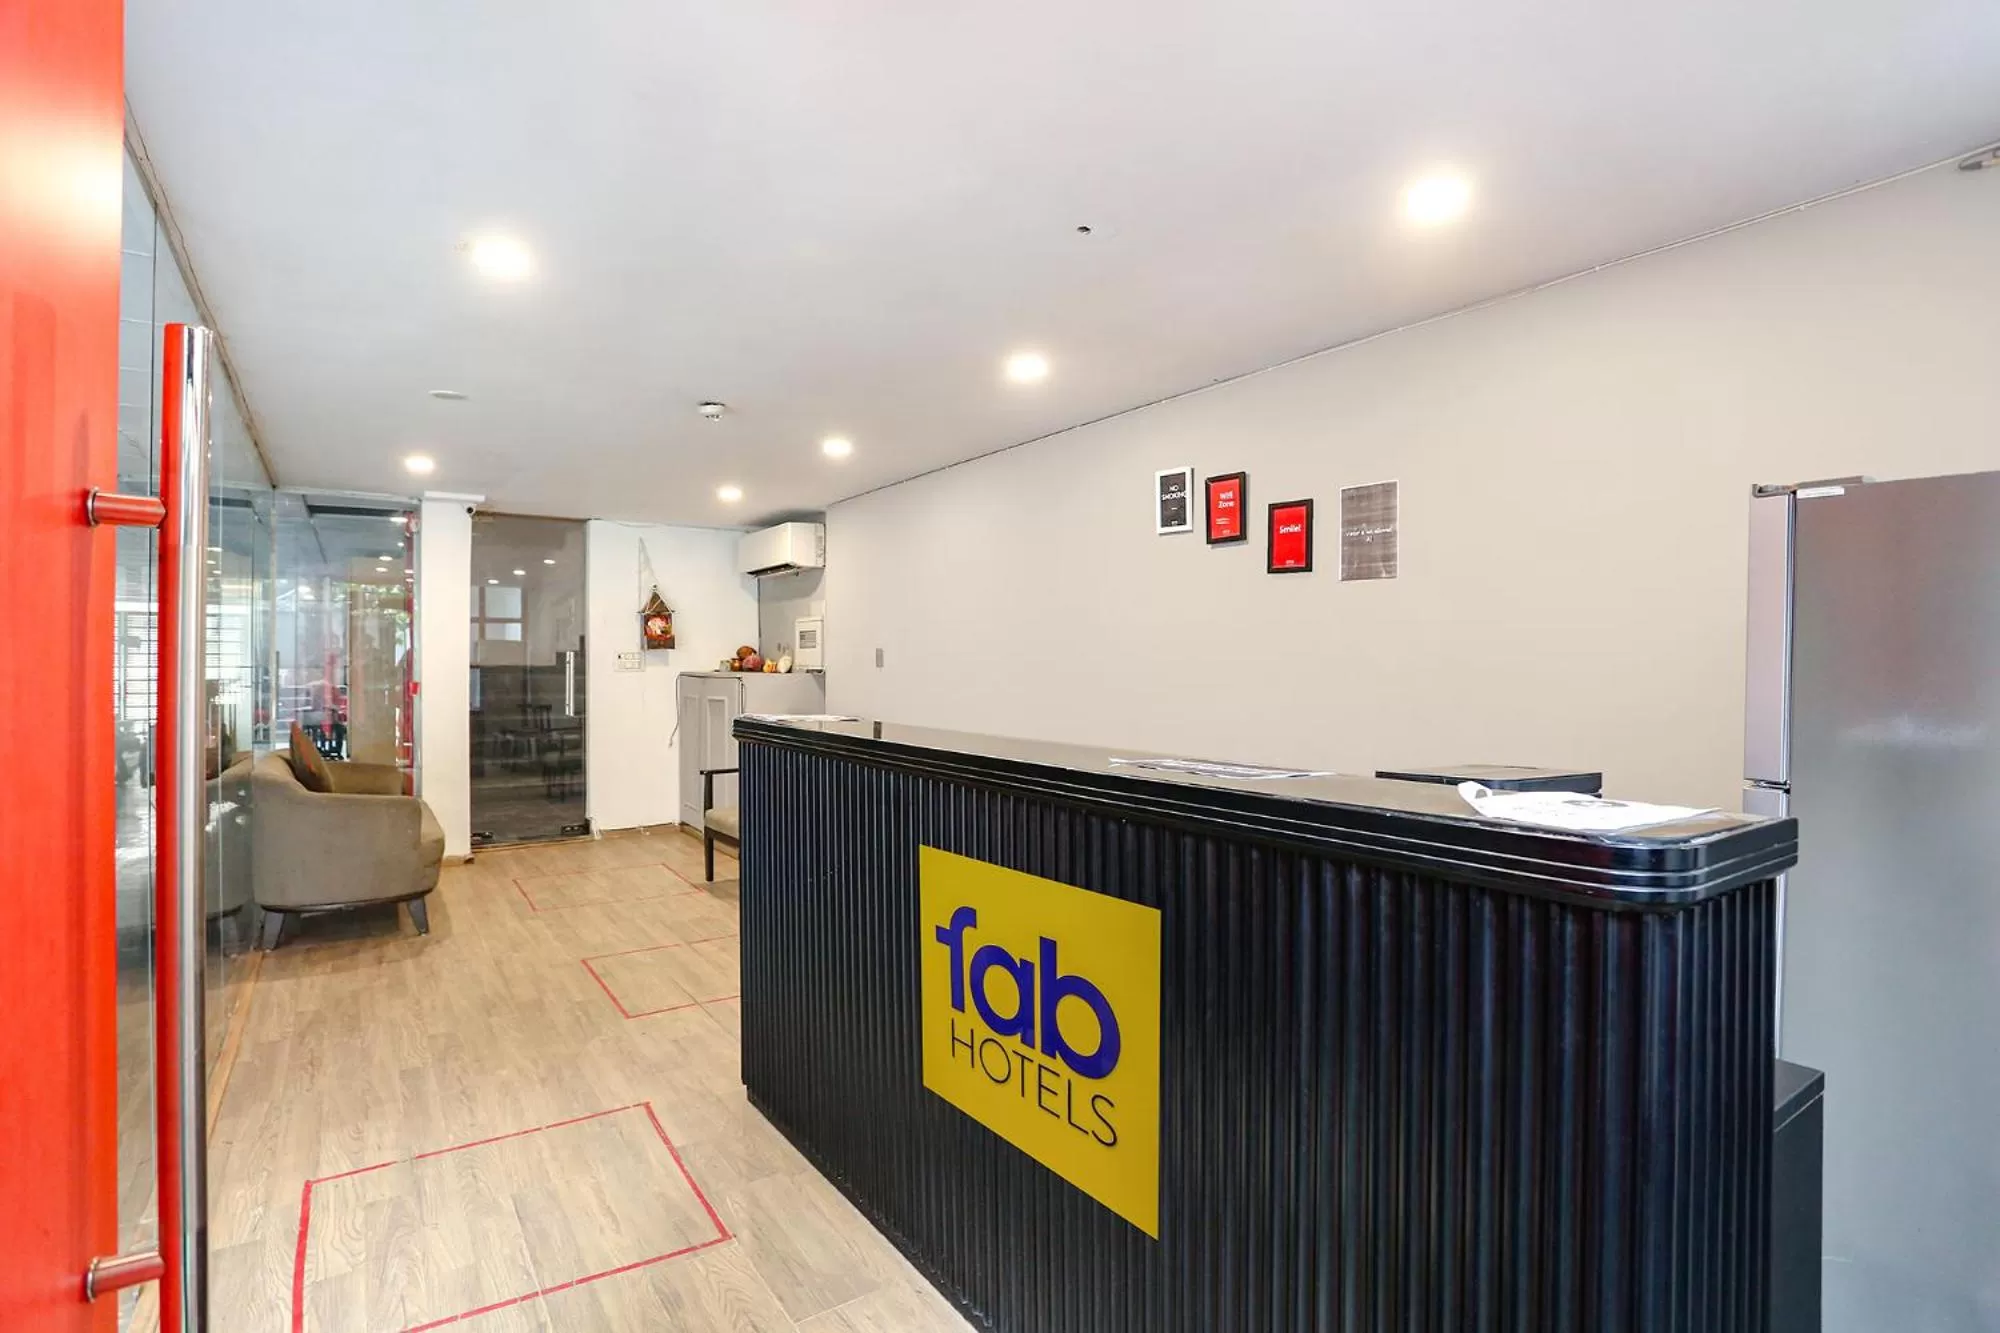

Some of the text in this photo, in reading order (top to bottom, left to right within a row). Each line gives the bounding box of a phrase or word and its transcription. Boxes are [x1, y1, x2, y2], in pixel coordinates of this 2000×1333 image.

[1217, 500, 1235, 509] Zone
[936, 906, 1121, 1079] fab
[951, 1017, 1118, 1147] HOTELS
